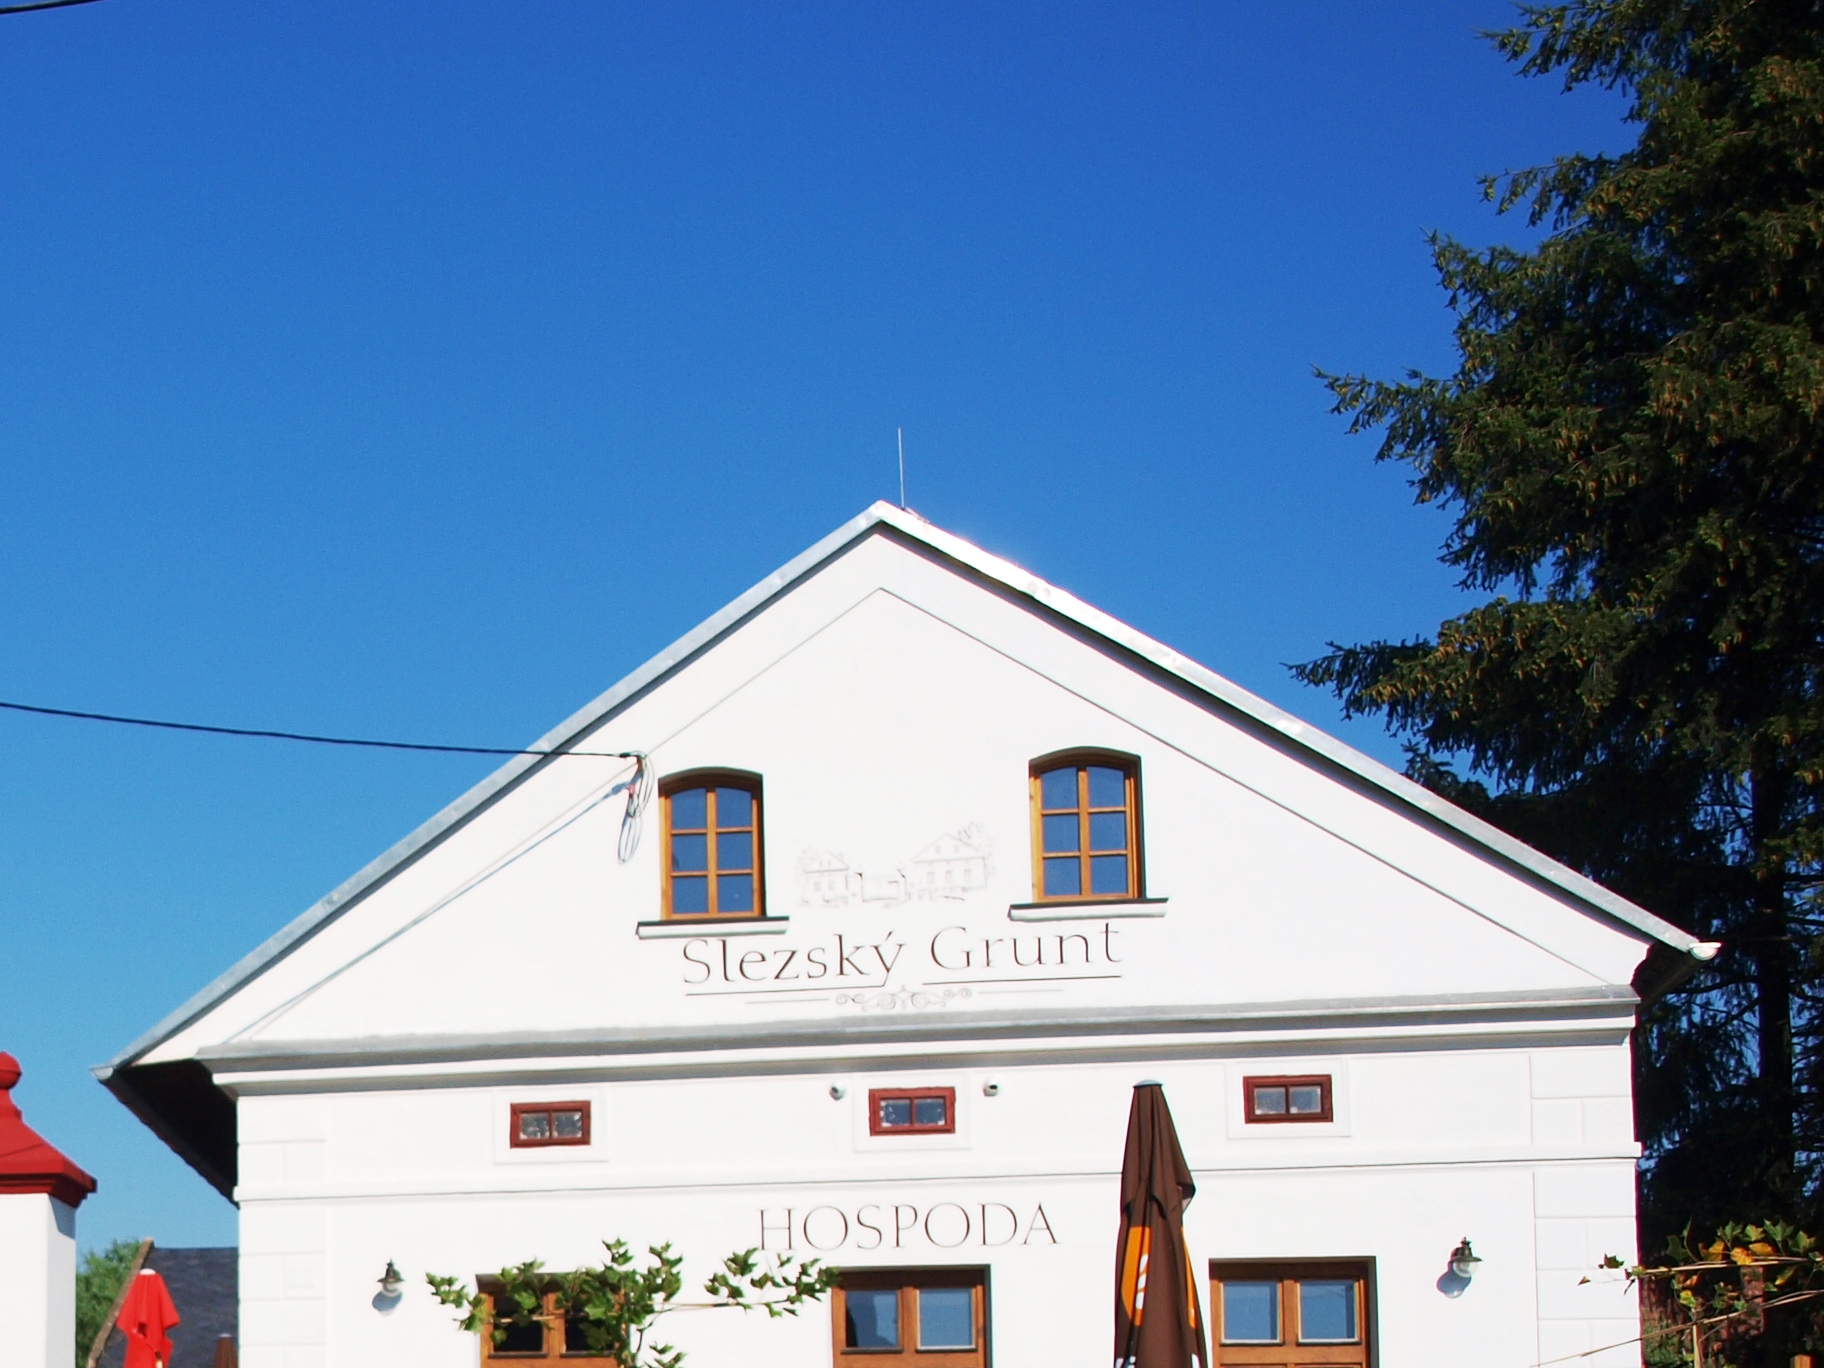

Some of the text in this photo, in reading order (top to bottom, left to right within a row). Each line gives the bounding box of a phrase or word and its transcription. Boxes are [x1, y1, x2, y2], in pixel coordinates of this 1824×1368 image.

[682, 922, 1123, 985] Slezský Grunt
[756, 1202, 1062, 1251] HOSPODA
